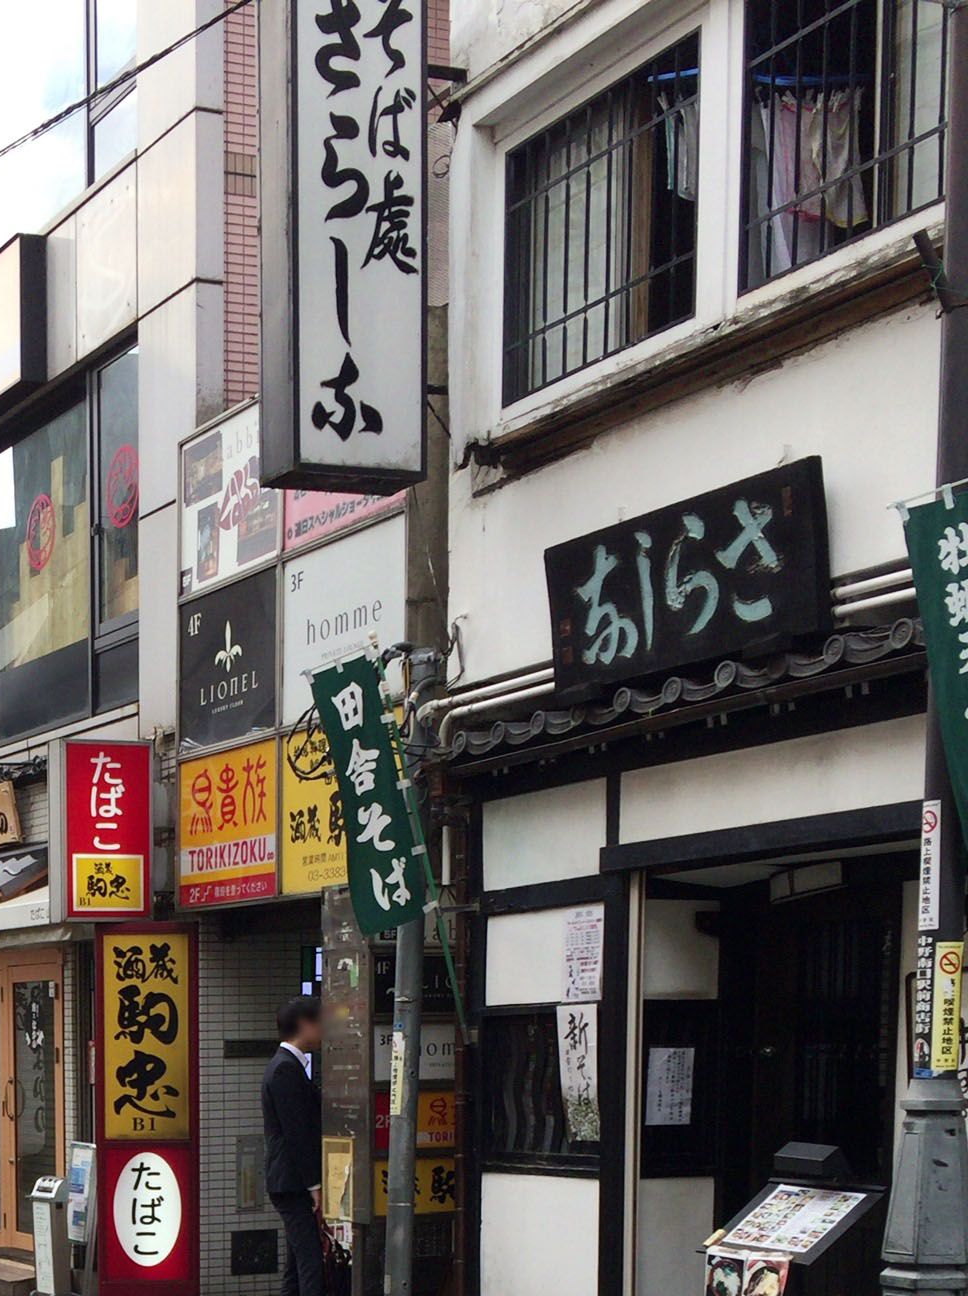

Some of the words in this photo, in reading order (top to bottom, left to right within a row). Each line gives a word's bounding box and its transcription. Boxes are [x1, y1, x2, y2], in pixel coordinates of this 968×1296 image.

[290, 570, 305, 593] 3F
[187, 612, 202, 637] 4F
[306, 600, 383, 646] homme
[90, 751, 126, 850] たばこ
[331, 681, 411, 911] 田舎そば
[188, 837, 266, 873] TORIKIZOKU
[189, 886, 201, 903] 2F
[131, 1162, 164, 1255] たばこ
